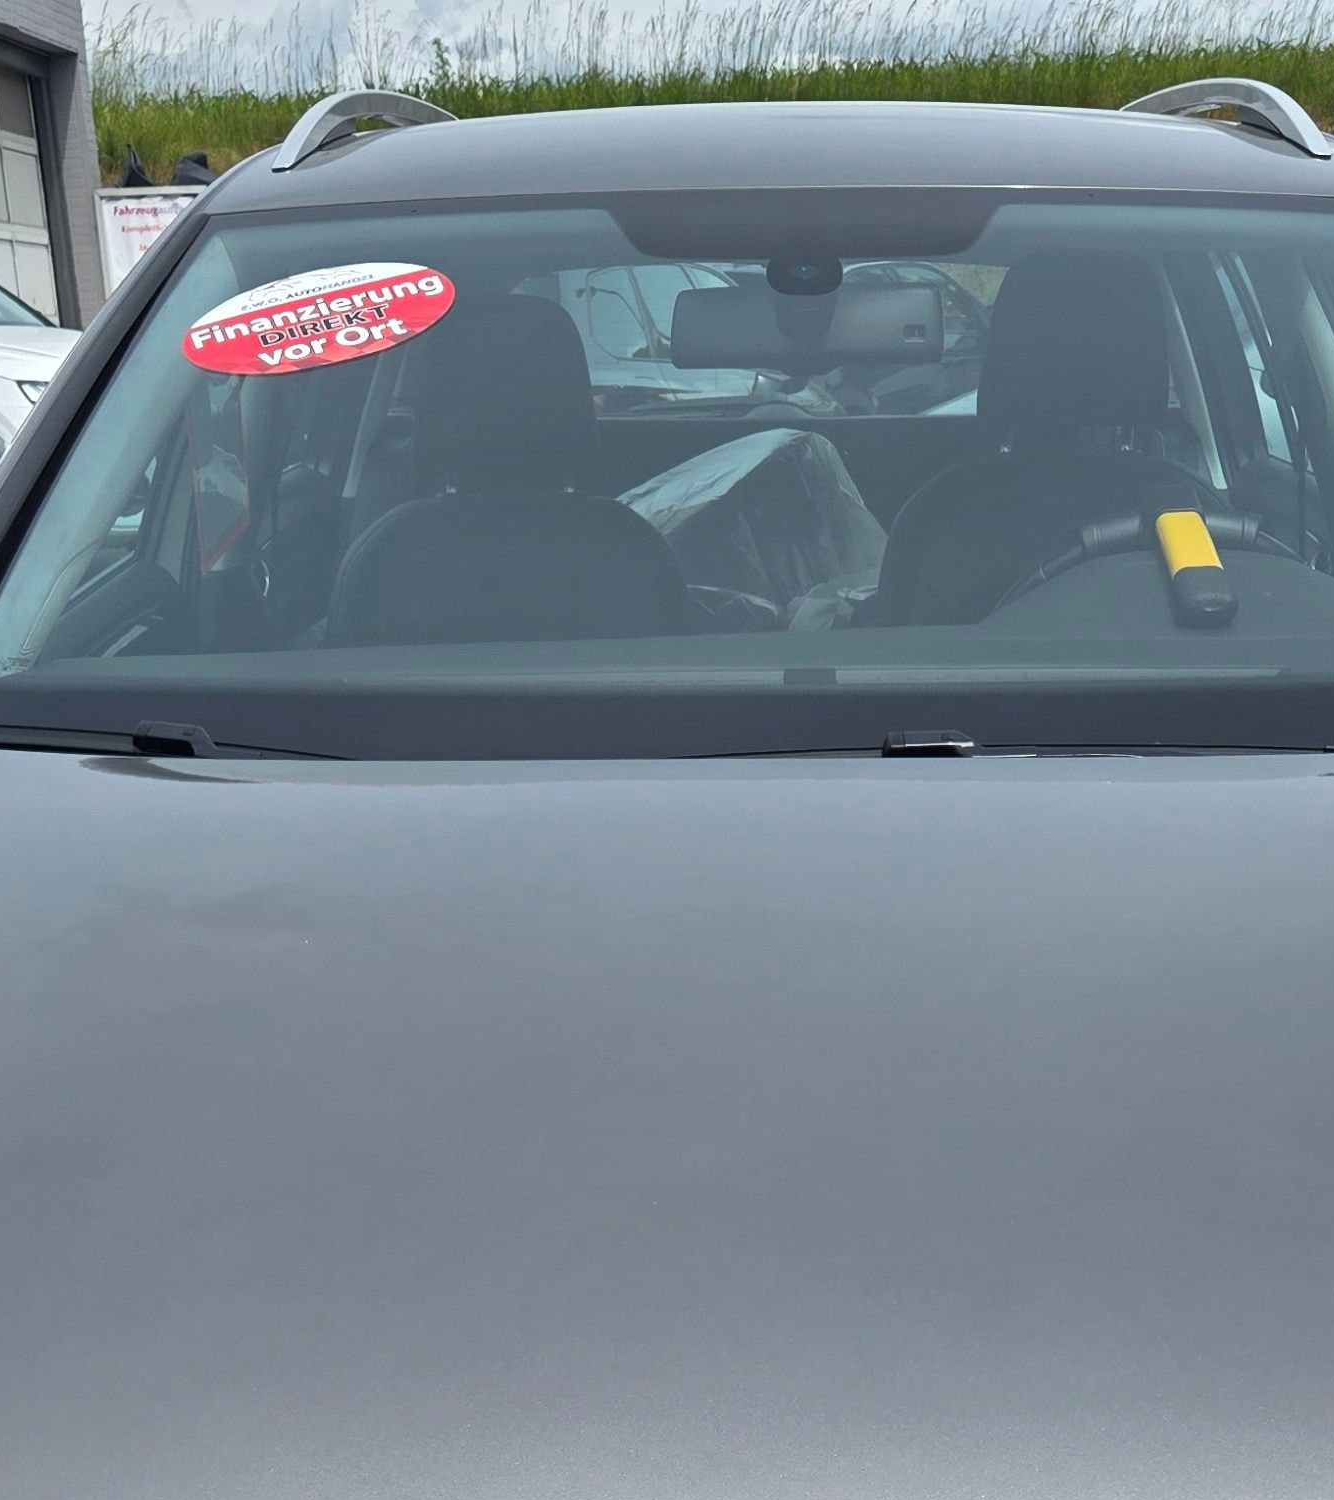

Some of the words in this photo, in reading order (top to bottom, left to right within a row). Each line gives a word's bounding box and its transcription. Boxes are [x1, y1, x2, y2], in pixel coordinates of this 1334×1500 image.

[189, 273, 444, 350] Finanzierung
[258, 303, 389, 347] DIREKT
[257, 337, 327, 367] vor
[335, 315, 407, 347] Ort
